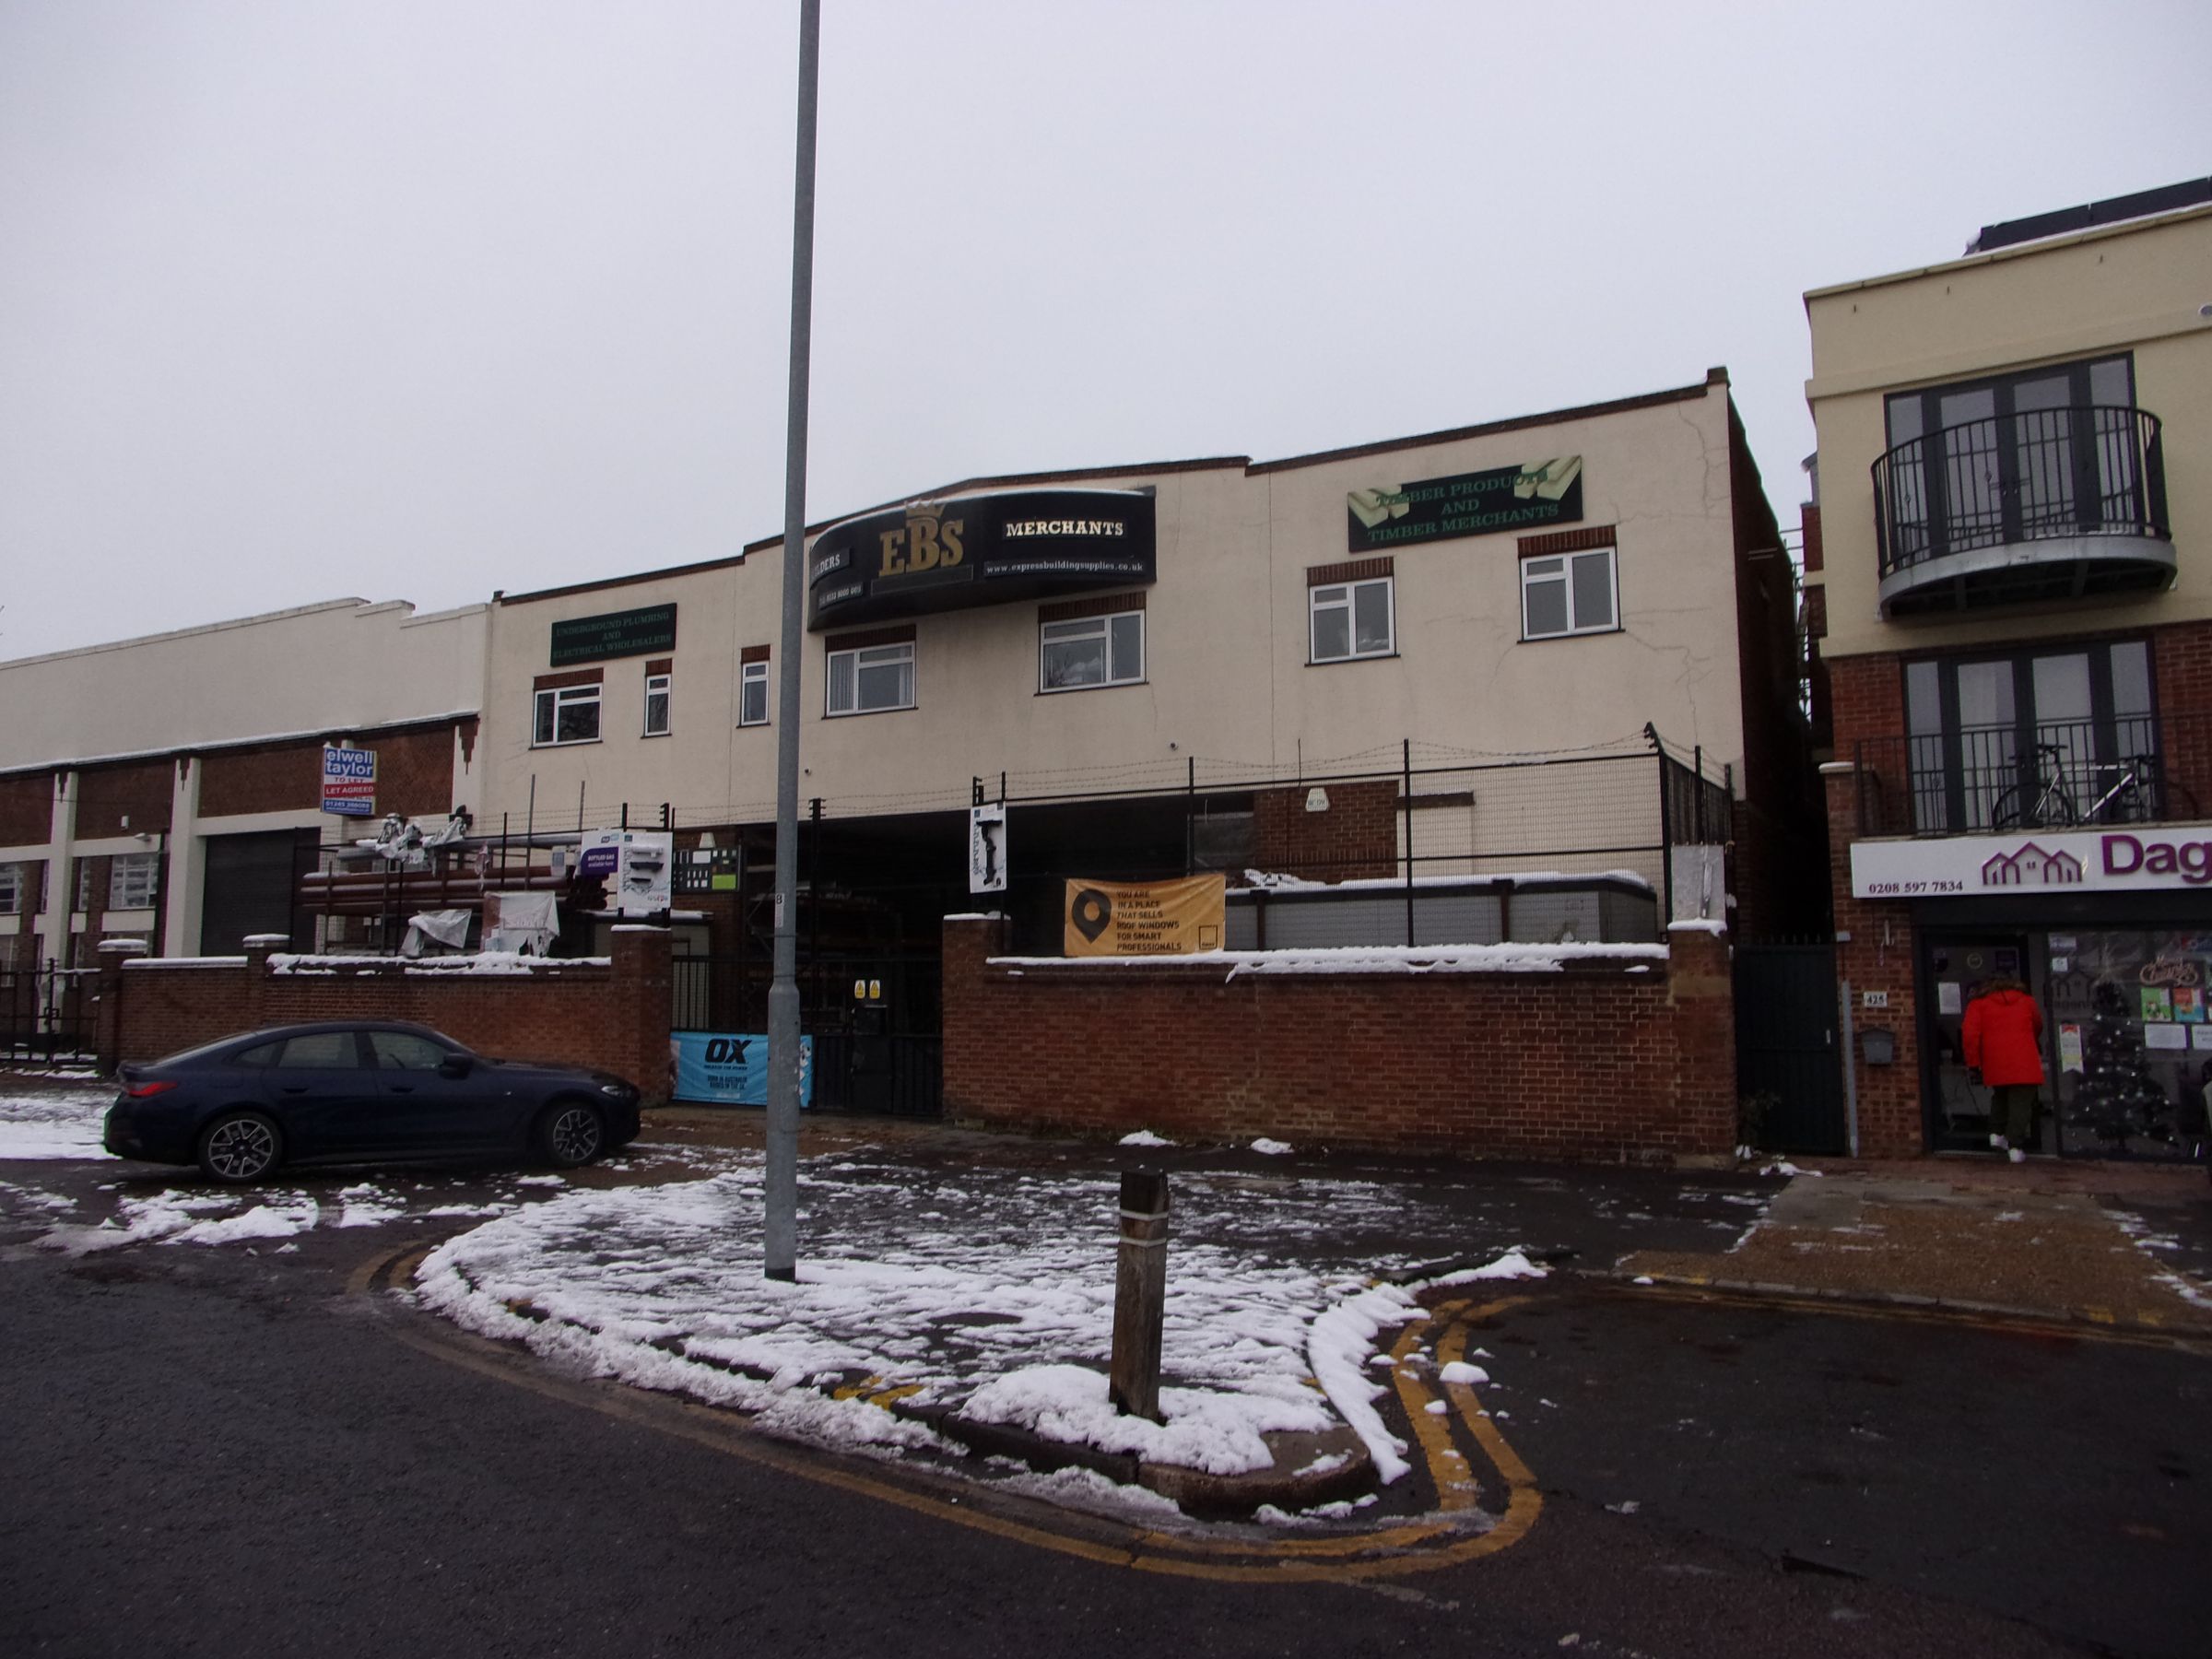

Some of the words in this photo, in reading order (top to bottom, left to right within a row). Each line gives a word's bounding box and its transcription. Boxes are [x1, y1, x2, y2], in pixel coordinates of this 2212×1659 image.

[1441, 499, 1479, 516] AND
[1006, 520, 1124, 537] MERCHANTS
[1367, 524, 1437, 543] TIMBER
[1441, 503, 1559, 532] MERCHANTS
[877, 514, 965, 578] EBS
[986, 561, 1144, 575] www.expressbuildingsupplies.co.uk
[602, 630, 621, 641] AND
[326, 748, 373, 764] elwell
[326, 761, 373, 777] taylor
[2101, 834, 2212, 884] Dag
[1868, 883, 1900, 894] 0208
[1903, 881, 1927, 893] 597
[1931, 879, 1963, 893] 7834
[1116, 891, 1133, 900] YOU
[1135, 900, 1160, 909] PLACE
[1138, 911, 1163, 919] SELLS
[1116, 922, 1136, 930] ROOF
[1137, 921, 1180, 930] WINDOWS
[1116, 932, 1132, 940] FOR
[1133, 932, 1162, 940] SMART
[1116, 943, 1182, 952] PROFESSIONALS
[704, 1039, 752, 1064] OX
